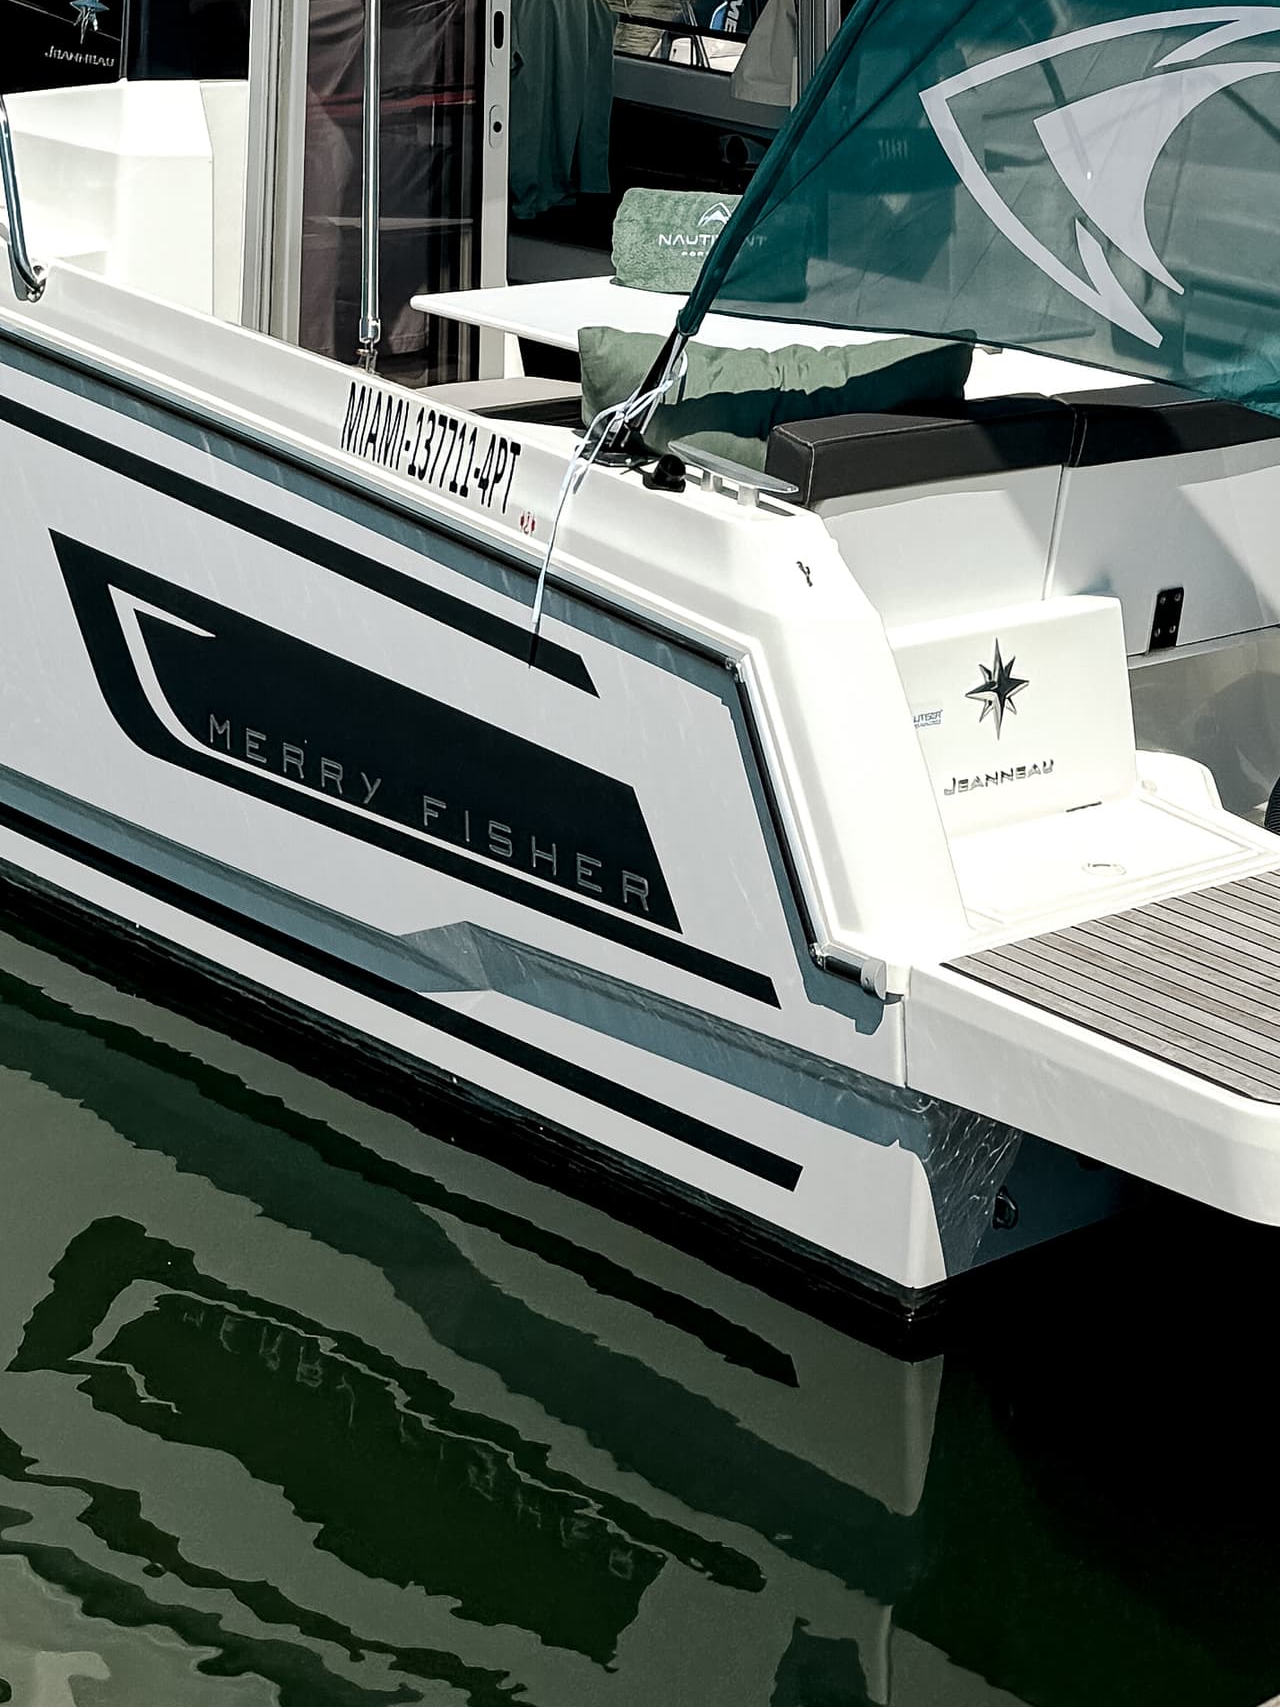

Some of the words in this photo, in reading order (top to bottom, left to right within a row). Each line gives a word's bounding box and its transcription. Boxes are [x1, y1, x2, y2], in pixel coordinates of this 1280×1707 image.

[340, 381, 522, 515] MIAMI-137711-4PT
[209, 713, 382, 804] MERRY
[422, 794, 650, 912] FISHER
[943, 758, 1055, 796] JEANNEAU
